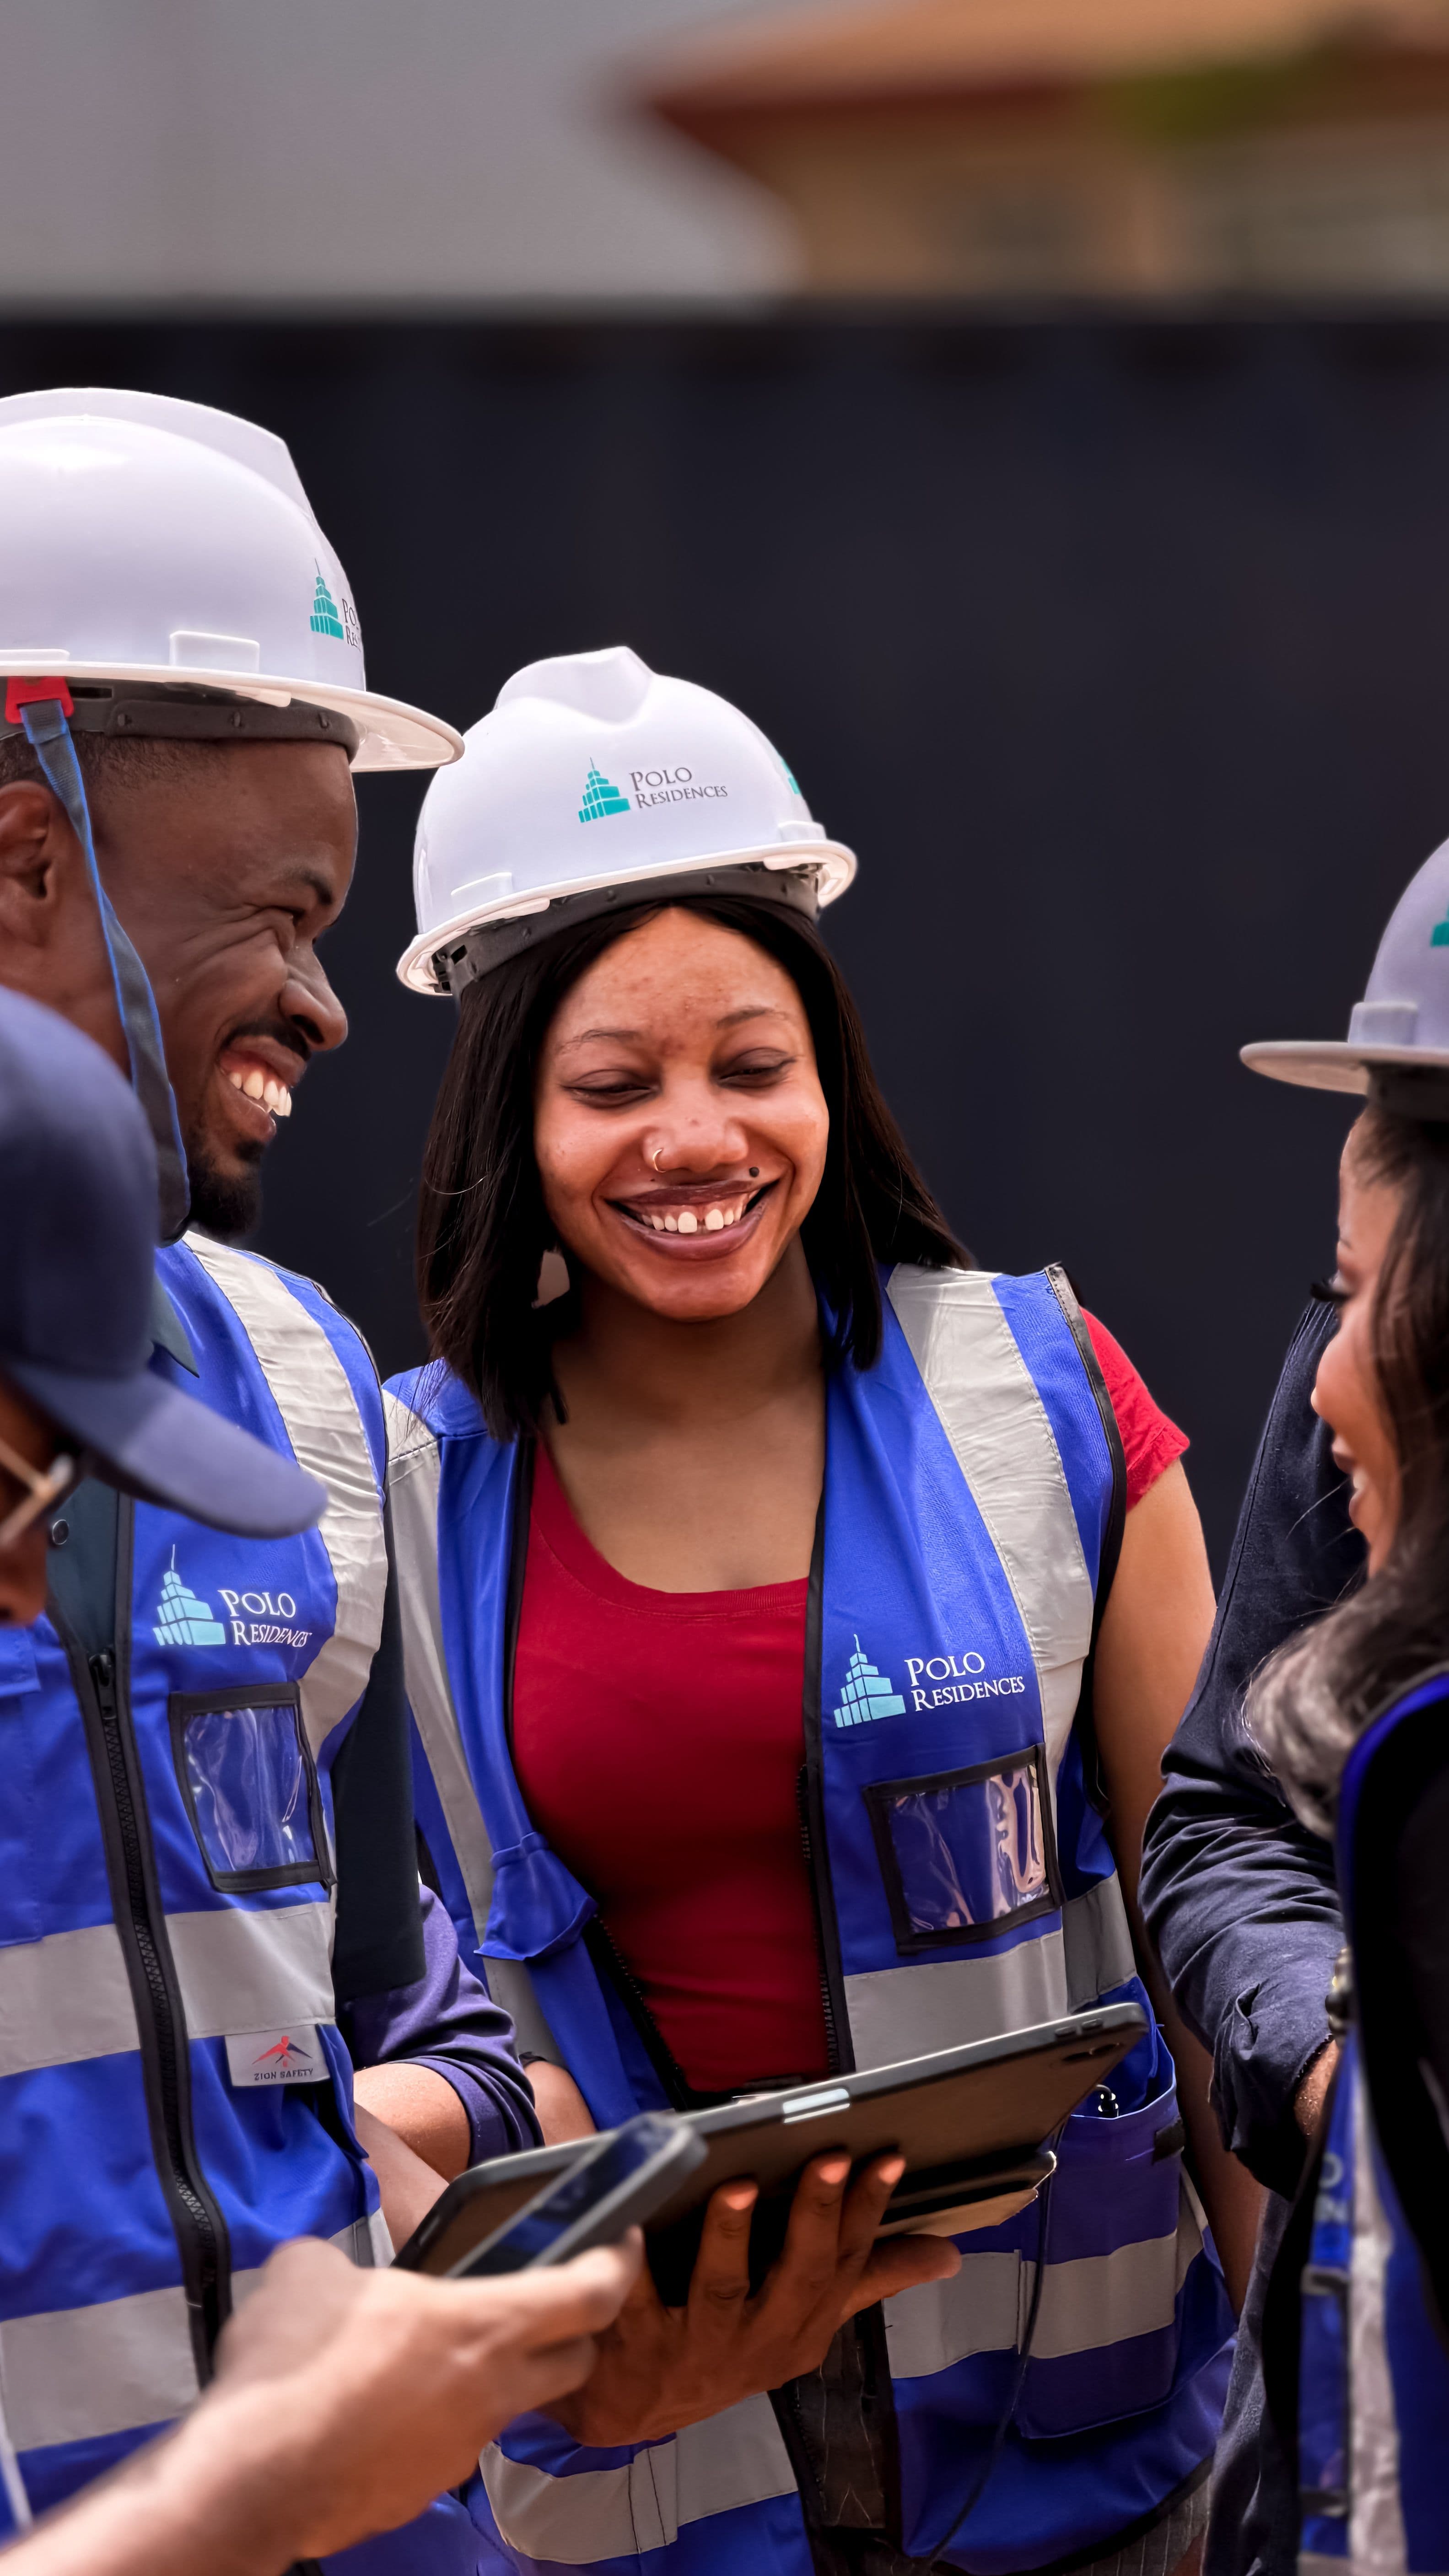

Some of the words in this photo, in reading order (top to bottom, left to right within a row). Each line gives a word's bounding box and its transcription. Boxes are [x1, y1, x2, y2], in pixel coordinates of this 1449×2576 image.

[629, 767, 692, 791] POLO
[635, 785, 728, 808] RESIDENCES
[217, 1590, 296, 1618] POLO
[905, 1652, 986, 1687] POLO
[911, 1676, 1025, 1712] RESIDENCES
[254, 2071, 276, 2081] ZION
[280, 2068, 313, 2078] SAFETY
